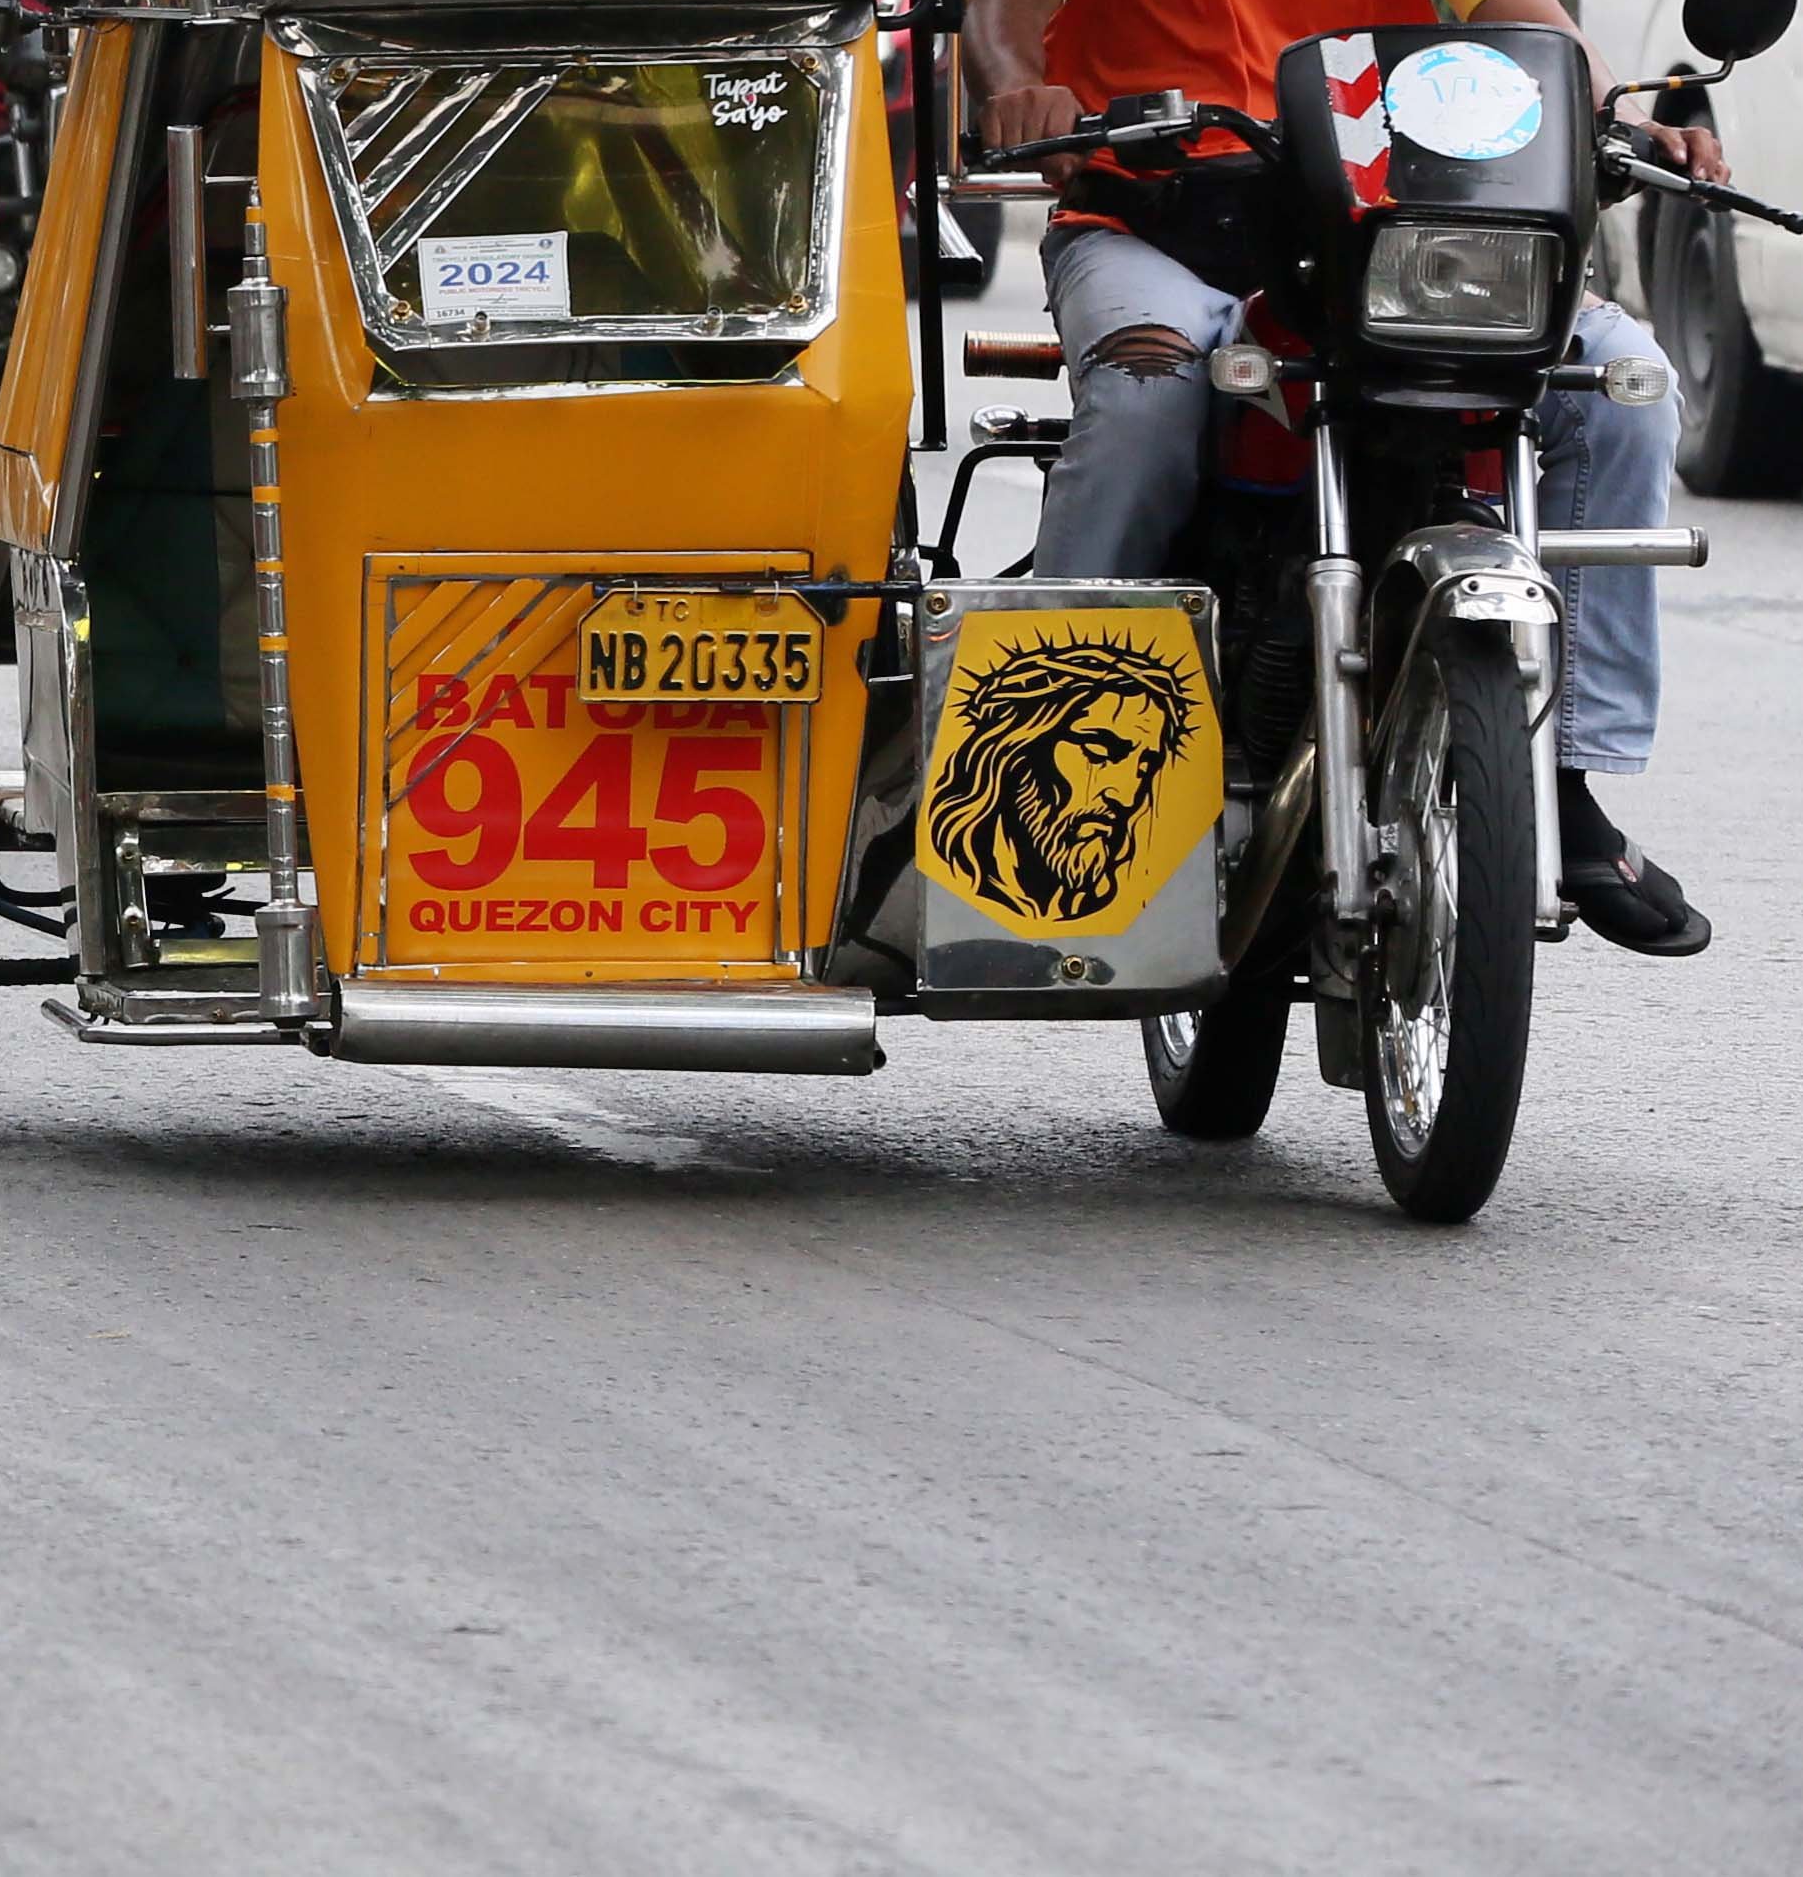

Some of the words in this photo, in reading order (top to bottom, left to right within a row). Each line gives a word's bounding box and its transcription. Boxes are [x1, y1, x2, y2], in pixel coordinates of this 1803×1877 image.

[703, 71, 788, 103] Tapat
[712, 101, 789, 131] Sayo
[438, 260, 550, 287] 2024
[655, 598, 690, 622] TC
[405, 733, 767, 893] 945
[409, 899, 624, 935] QUEZON
[639, 899, 761, 934] CITY
